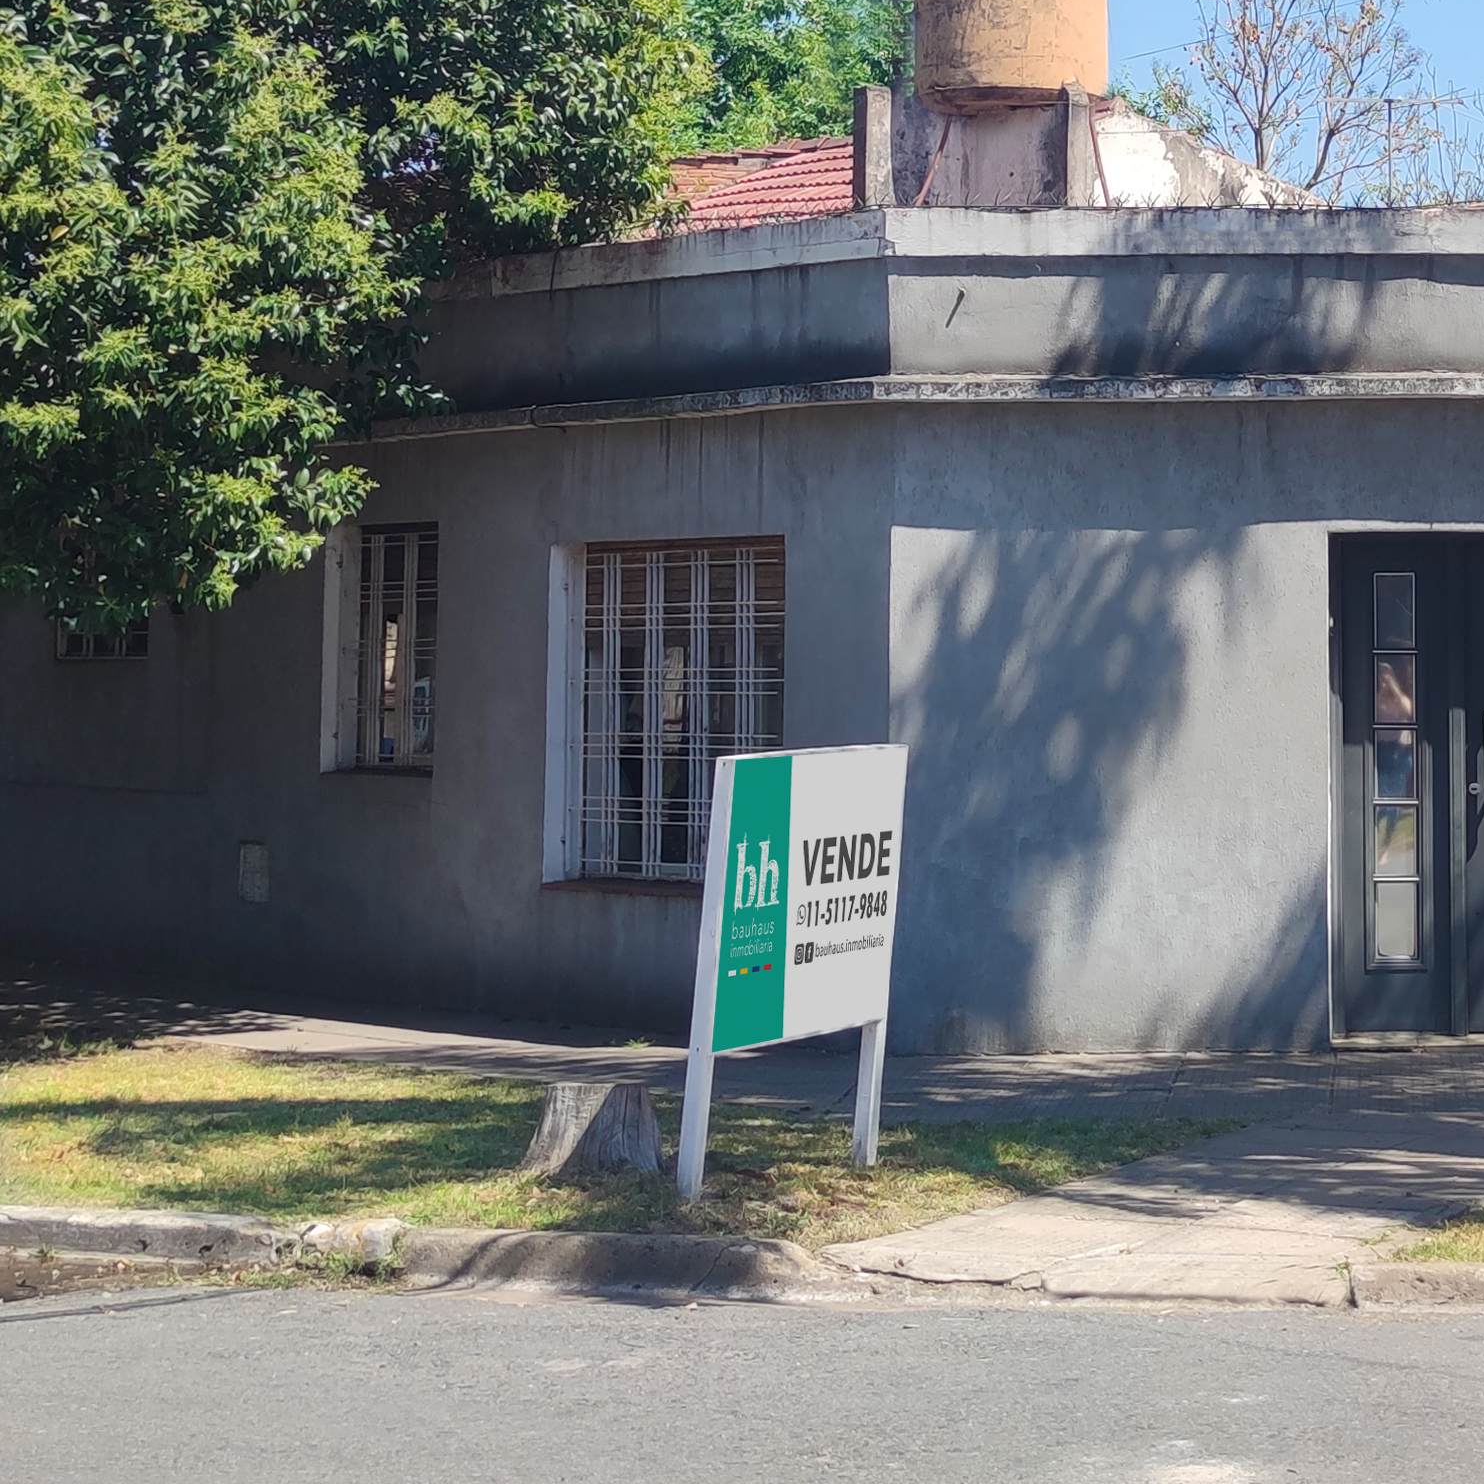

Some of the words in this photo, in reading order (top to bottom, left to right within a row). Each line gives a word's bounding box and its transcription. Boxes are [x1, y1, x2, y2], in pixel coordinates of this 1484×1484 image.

[733, 832, 780, 915] bh
[803, 830, 893, 887] VENDE
[807, 890, 888, 928] 11-5117-9848
[731, 917, 775, 940] bauhaus
[730, 938, 773, 958] inmobiliaria
[814, 933, 885, 958] bauhaus.inmobiliaria
